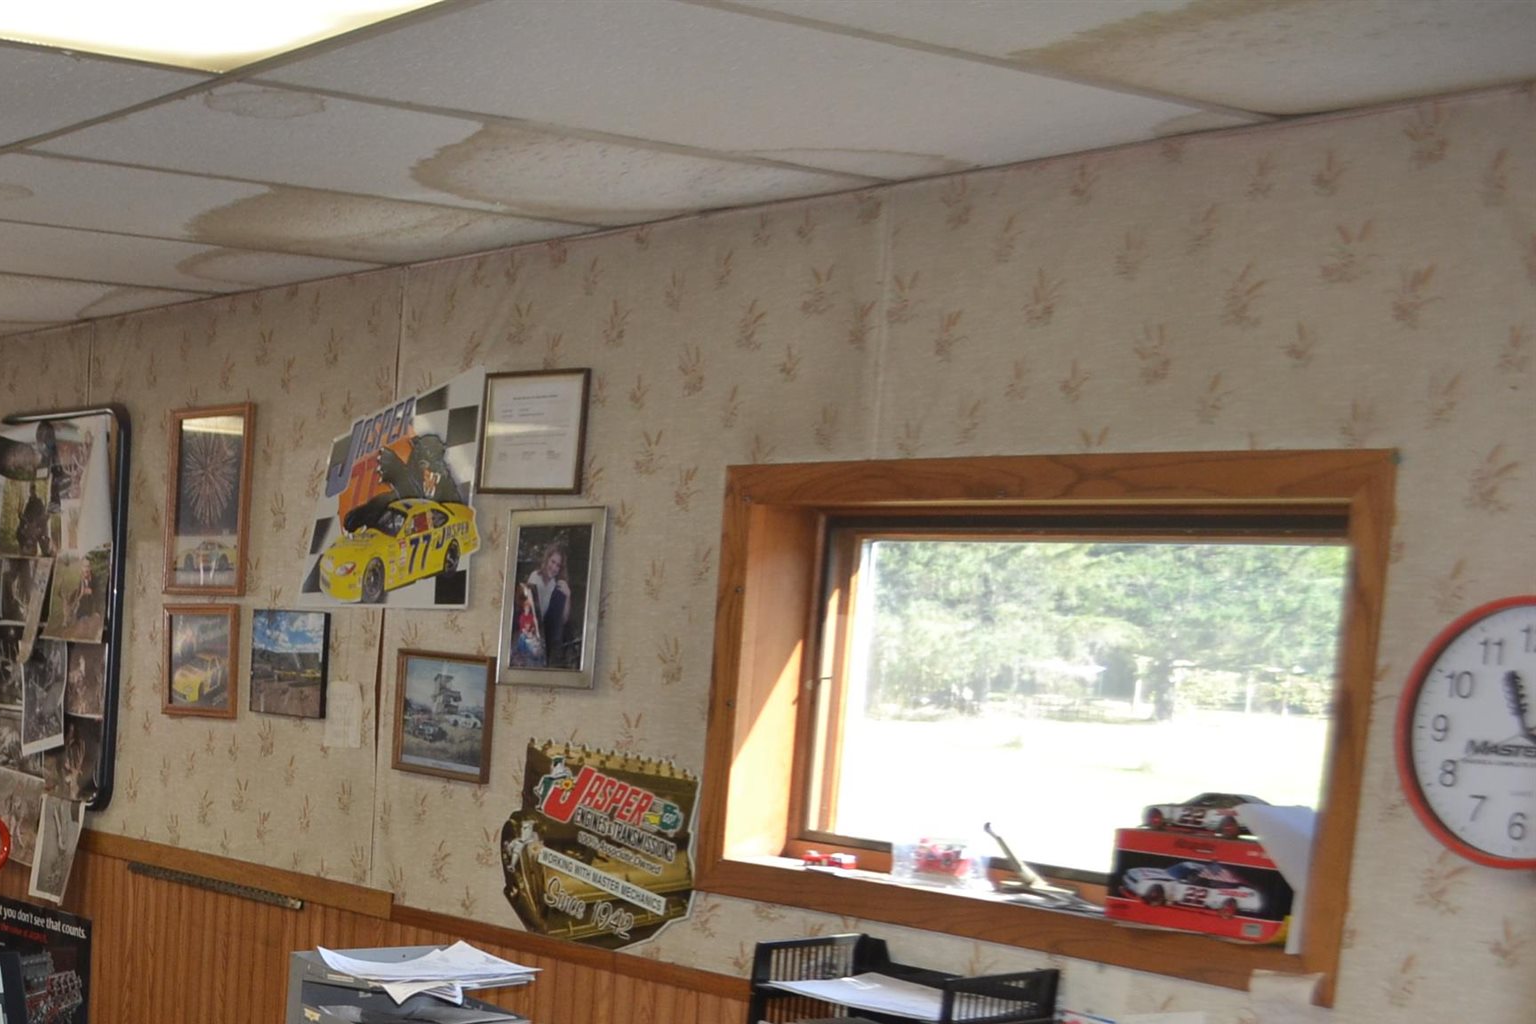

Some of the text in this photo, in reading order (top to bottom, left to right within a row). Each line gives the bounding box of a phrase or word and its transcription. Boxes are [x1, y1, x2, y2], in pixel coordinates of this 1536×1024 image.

[326, 396, 416, 498] JASPER
[409, 534, 432, 574] 77
[1479, 638, 1505, 665] 11
[1446, 671, 1474, 698] 10
[1431, 714, 1449, 742] 9
[1439, 759, 1458, 787] 8
[543, 766, 655, 823] JASPER
[1469, 793, 1488, 822] 7
[575, 806, 609, 836] ENGINES
[614, 821, 676, 862] TRANSMISSIONS
[1507, 812, 1527, 841] 6
[542, 851, 663, 912] WORKING WITH MASTER MECHANICS
[3, 906, 17, 920] you
[17, 908, 34, 924] don't
[33, 915, 46, 928] see
[46, 917, 62, 933] that
[62, 922, 87, 939] counts.
